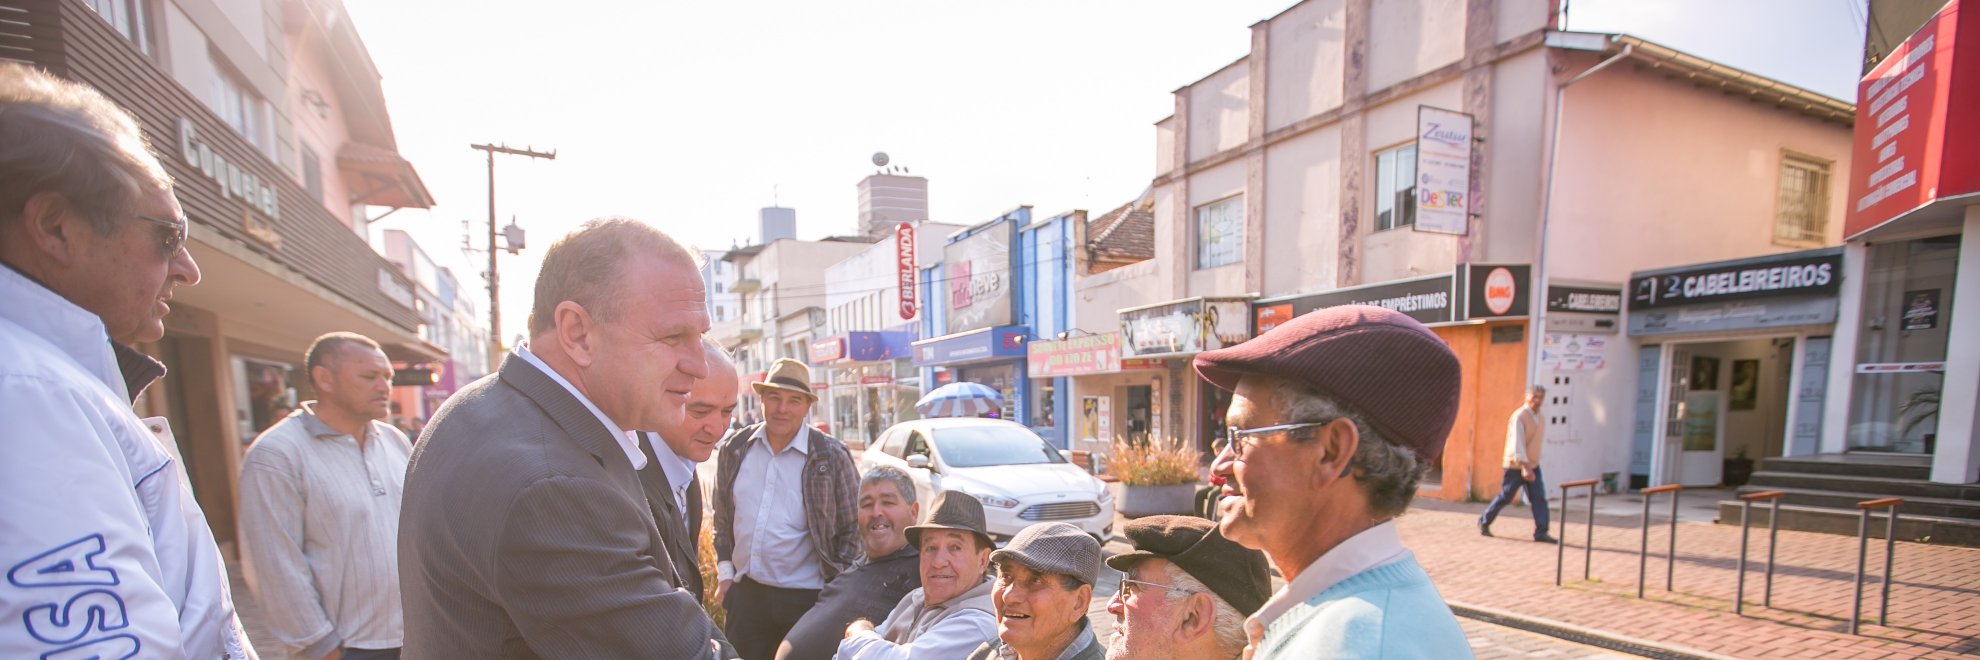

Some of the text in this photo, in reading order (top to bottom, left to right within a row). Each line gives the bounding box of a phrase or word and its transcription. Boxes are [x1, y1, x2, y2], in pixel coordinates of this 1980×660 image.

[900, 227, 914, 301] BERLANDA
[1683, 263, 1832, 298] CABELEIREIROS
[1381, 292, 1448, 312] EMPRÉSTIMOS
